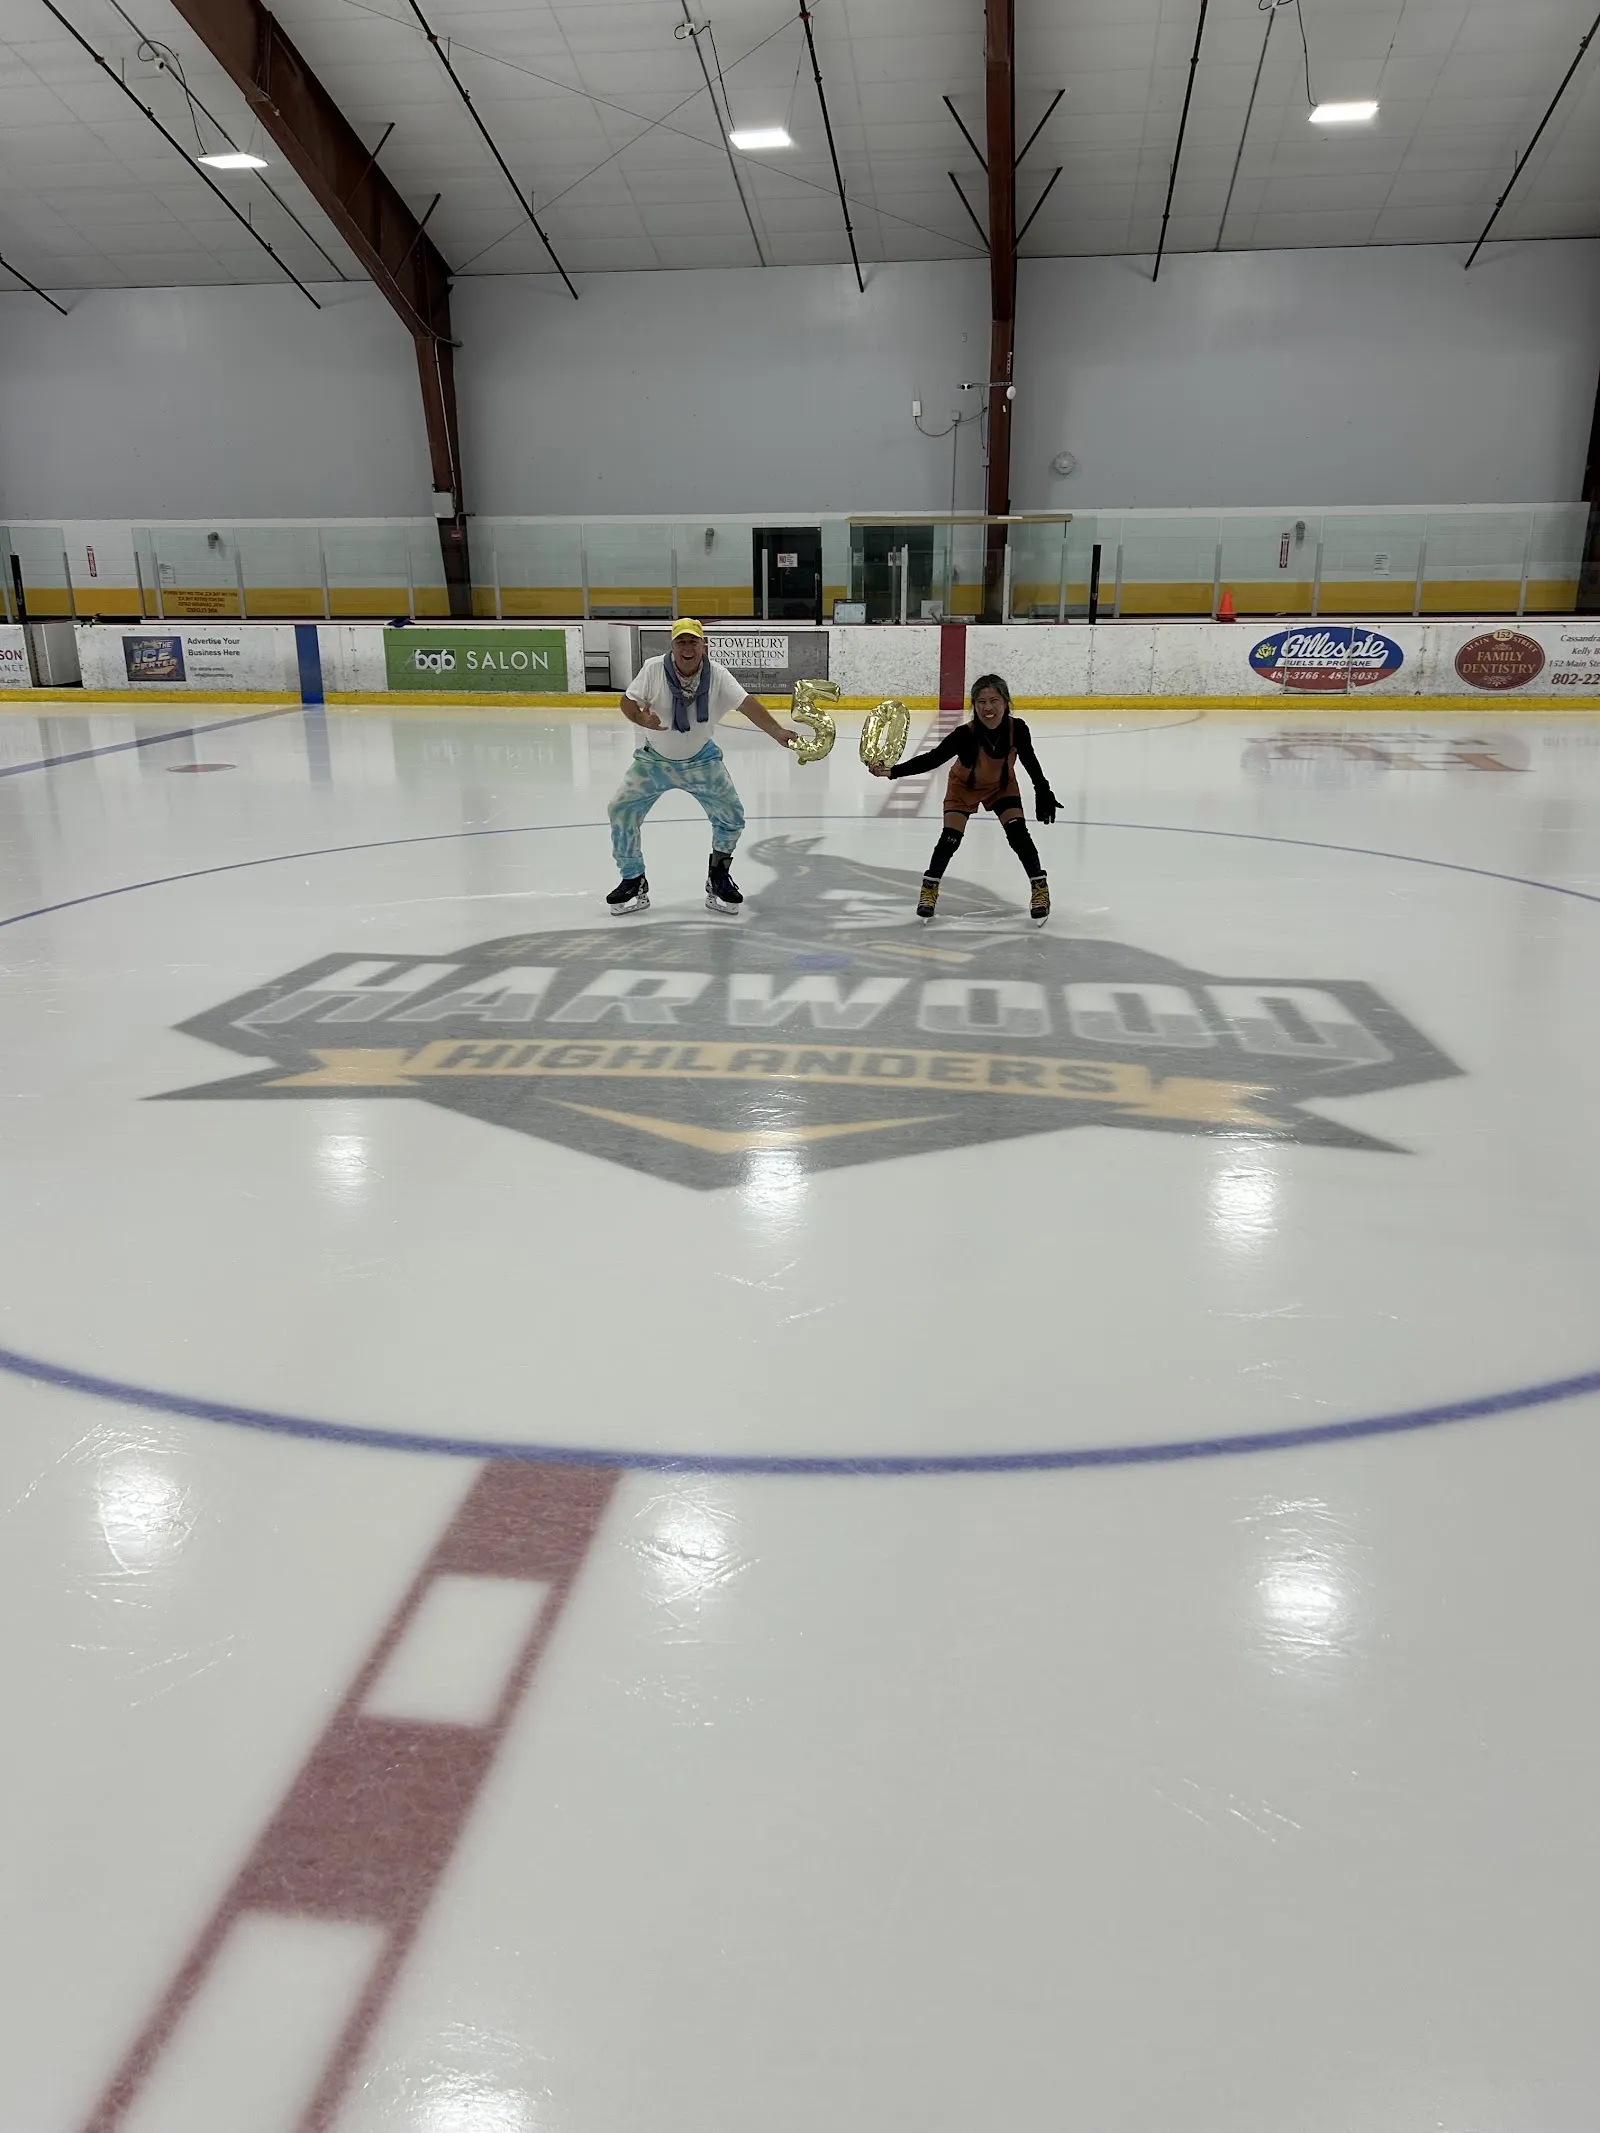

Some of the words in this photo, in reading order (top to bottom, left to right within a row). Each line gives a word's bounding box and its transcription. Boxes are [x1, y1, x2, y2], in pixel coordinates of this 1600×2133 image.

[1496, 631, 1511, 639] 152
[157, 641, 172, 649] THE
[709, 637, 785, 648] STOWEBURY
[1281, 632, 1388, 660] Gillespie
[1466, 637, 1490, 651] MAIN
[1513, 636, 1538, 653] STREET
[135, 649, 170, 663] ICE
[709, 650, 785, 659] CONSTRUCTION
[1477, 651, 1524, 661] FAMILY
[1571, 646, 1592, 656] Kelly
[466, 651, 548, 669] SALON
[1462, 663, 1536, 674] DENTISTRY
[1328, 671, 1379, 680] 4858033
[788, 679, 840, 765] 5
[859, 700, 910, 770] 0
[232, 960, 1394, 1063] HARWOOD
[437, 1043, 1120, 1094] HIGHLANDERS
